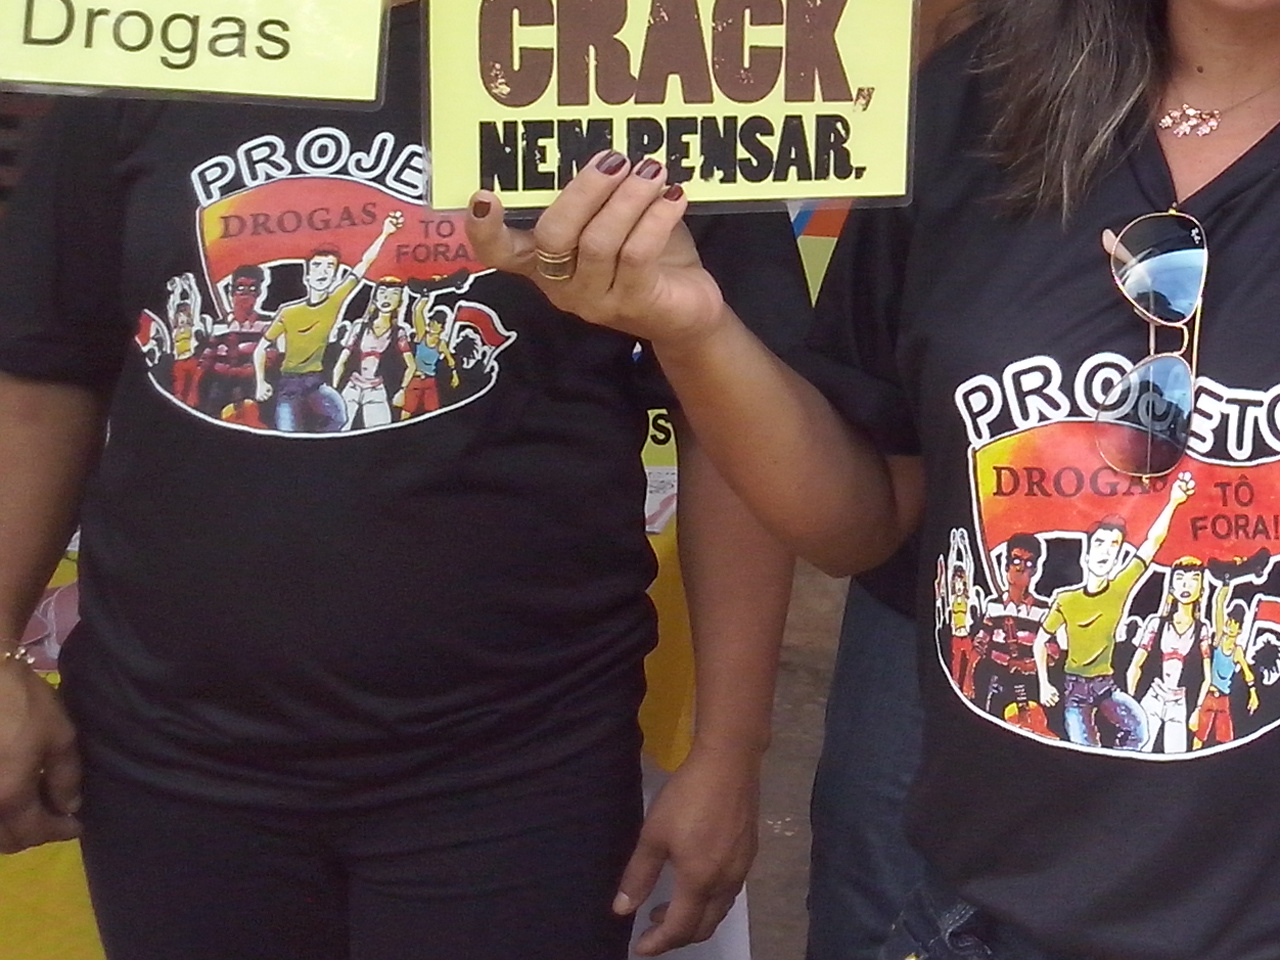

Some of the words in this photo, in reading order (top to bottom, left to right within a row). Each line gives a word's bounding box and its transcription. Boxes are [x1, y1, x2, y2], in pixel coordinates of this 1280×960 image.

[479, 118, 614, 193] NEM
[626, 114, 866, 189] PENSAR.
[219, 202, 378, 240] DROGAS
[1213, 474, 1255, 508] TÔ
[1190, 514, 1280, 541] FORA!
